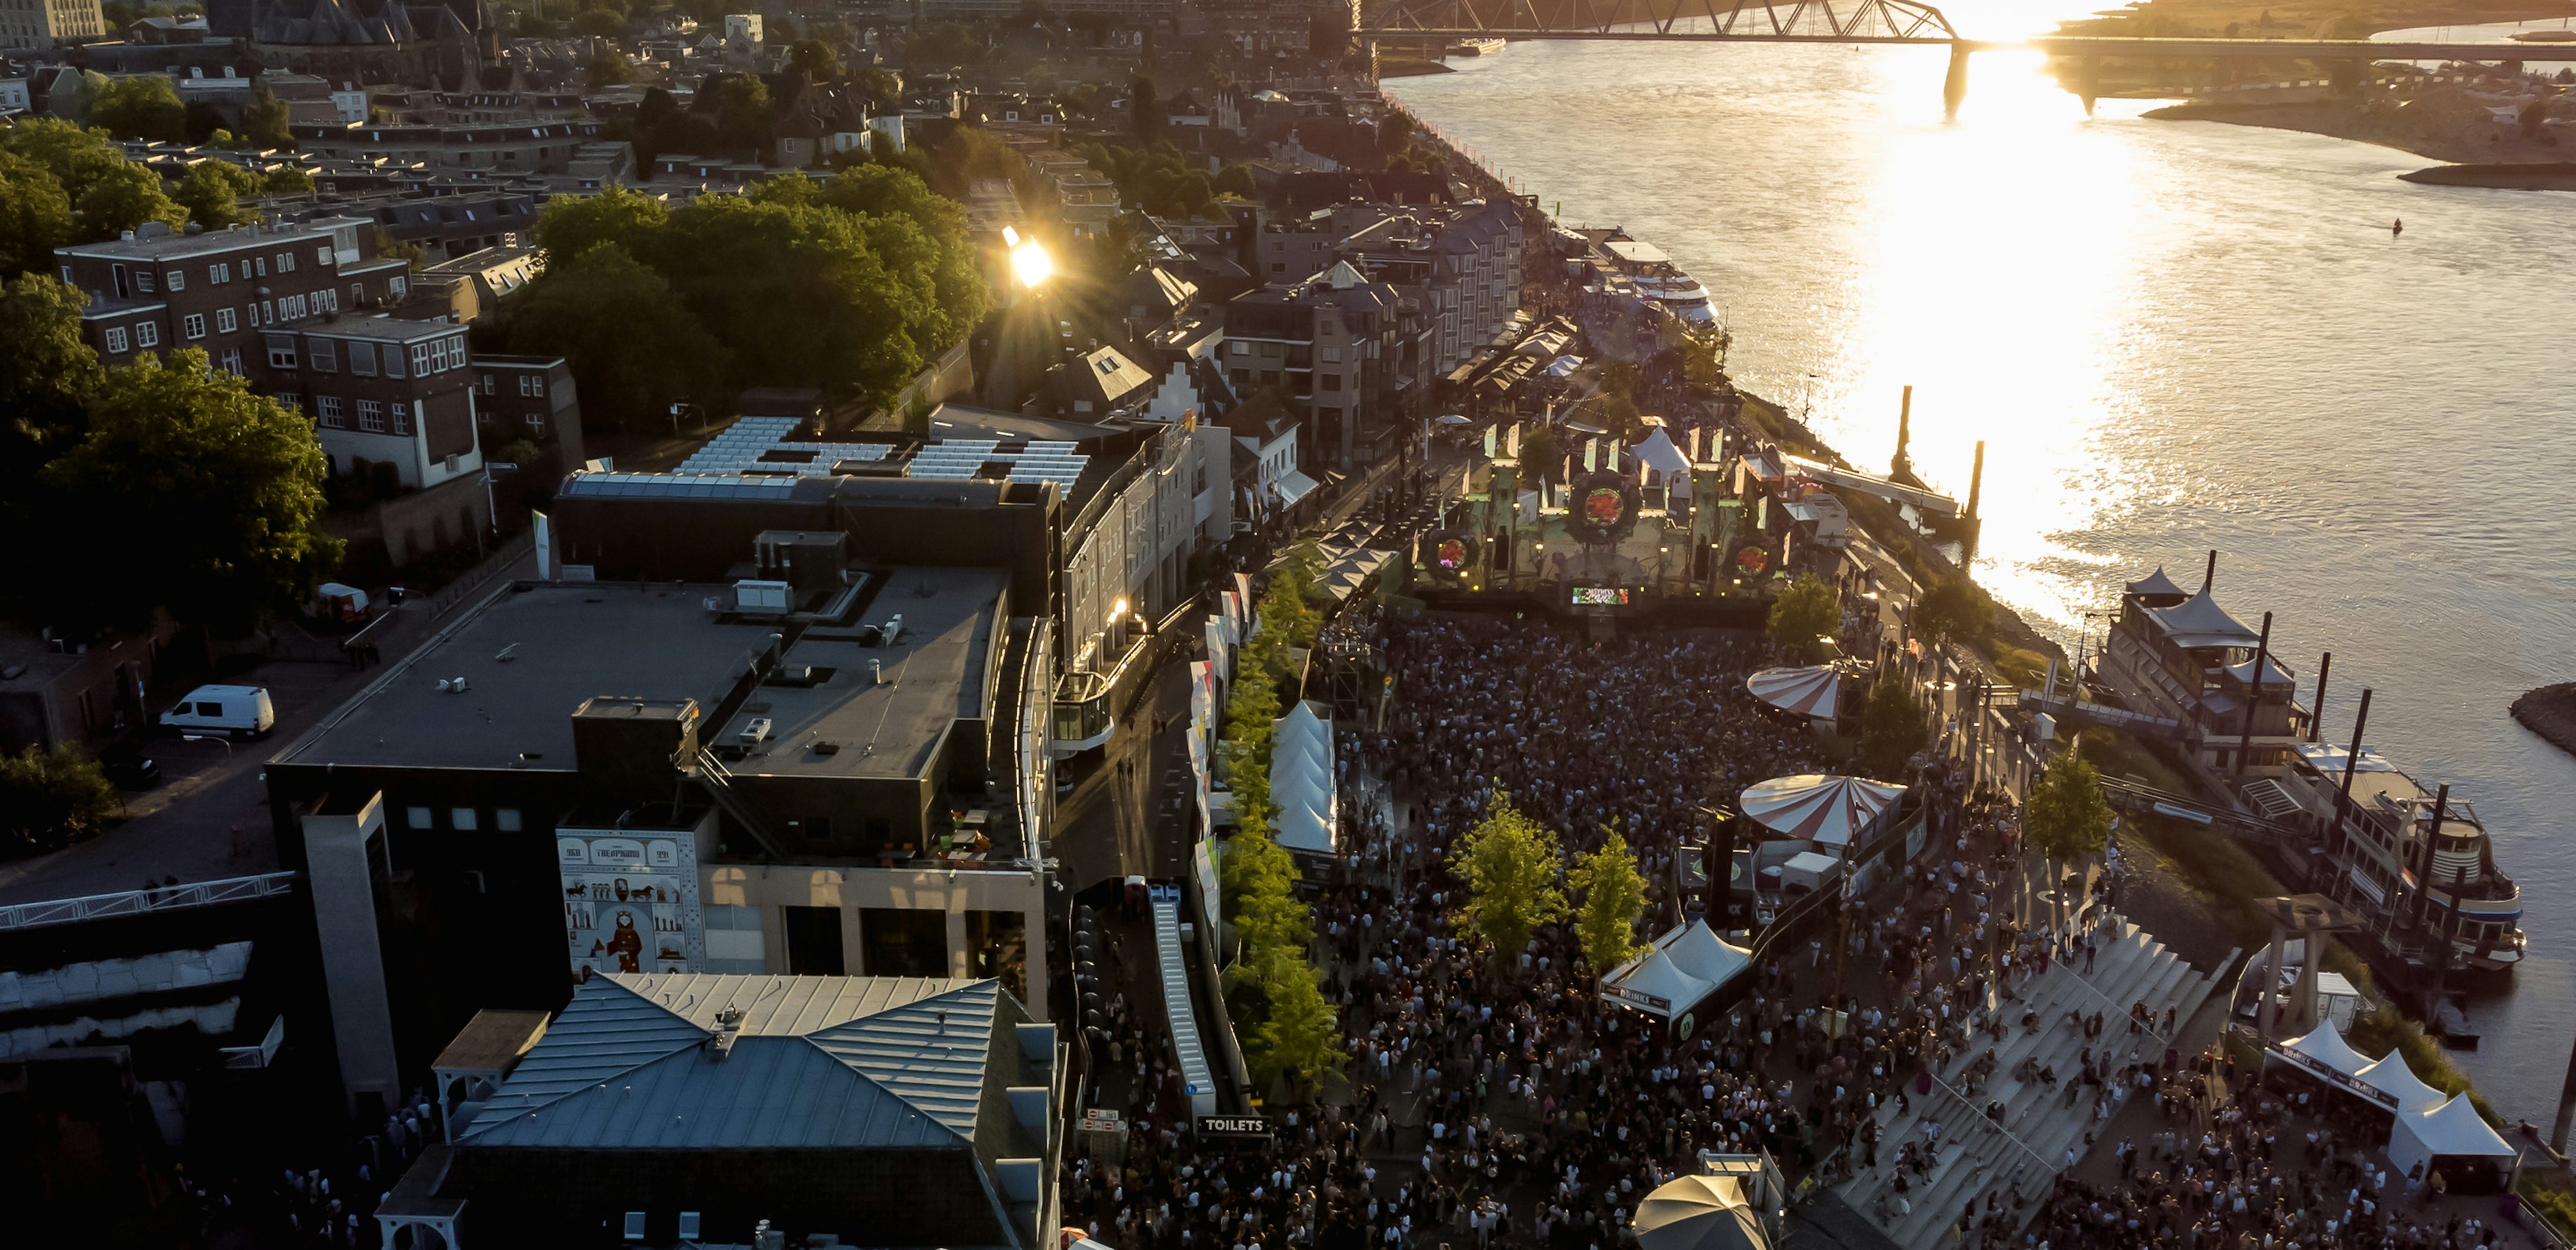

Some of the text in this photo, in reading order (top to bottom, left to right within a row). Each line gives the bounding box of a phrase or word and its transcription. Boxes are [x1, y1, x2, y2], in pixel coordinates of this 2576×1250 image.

[1620, 988, 1649, 1004] DRINKS
[2283, 1047, 2311, 1066] DRINKS
[2349, 1078, 2379, 1098] DRINKS
[1205, 1119, 1263, 1131] TOILETS
